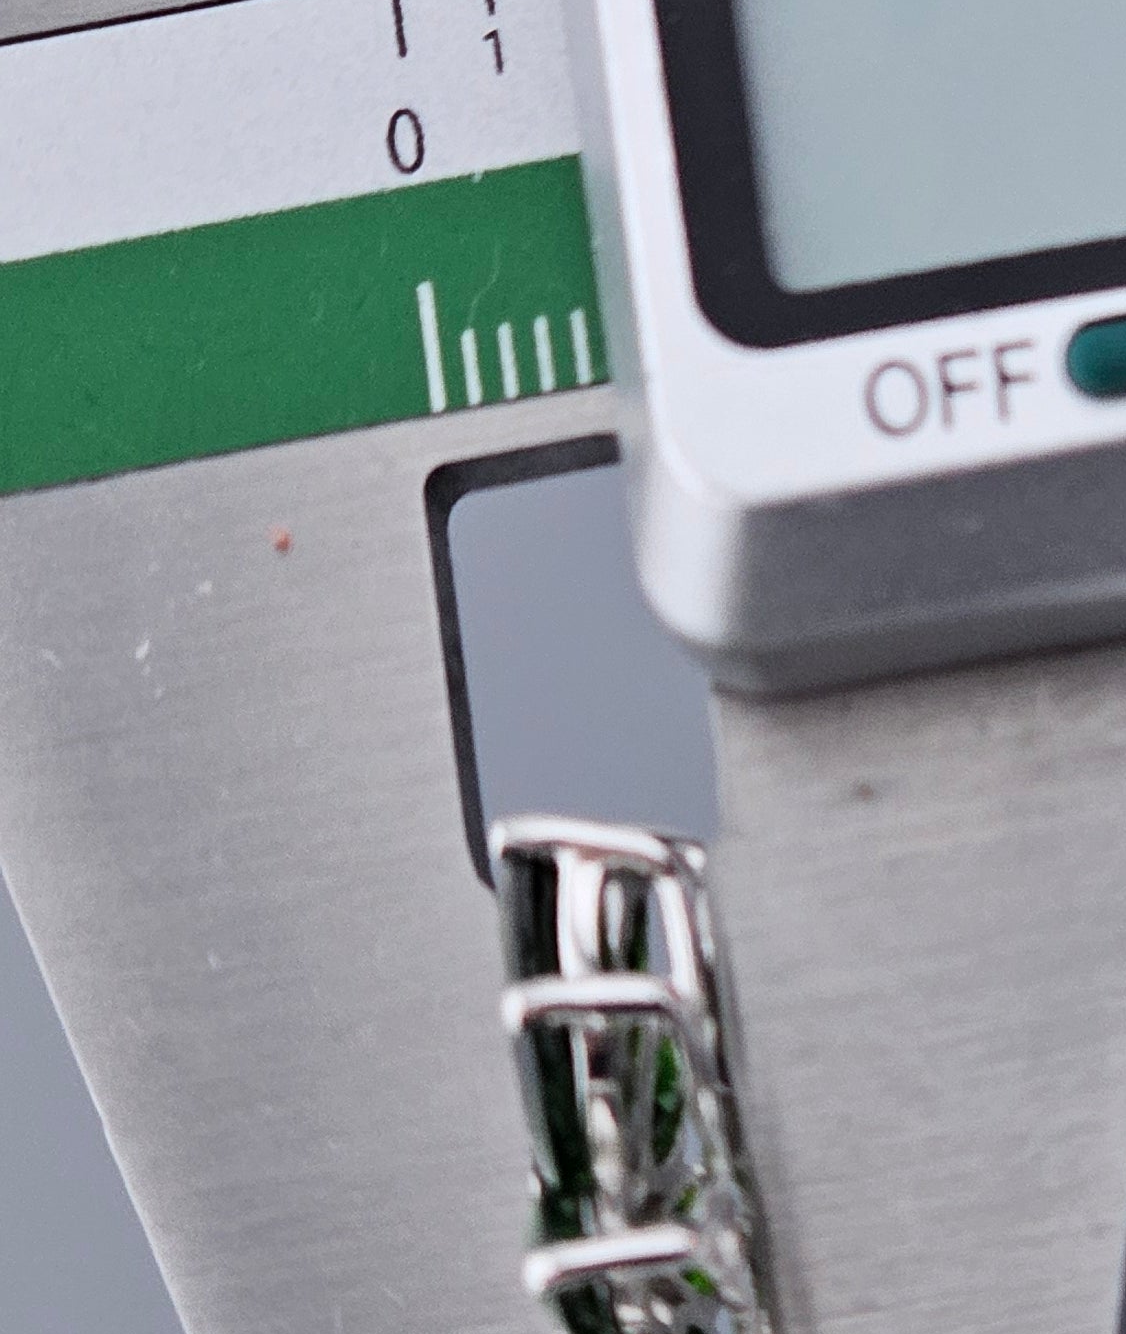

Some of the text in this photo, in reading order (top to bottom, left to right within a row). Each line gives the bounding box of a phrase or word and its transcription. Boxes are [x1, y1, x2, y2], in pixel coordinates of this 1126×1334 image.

[482, 29, 503, 75] 1
[386, 108, 425, 175] 0
[863, 337, 1037, 437] OFF
